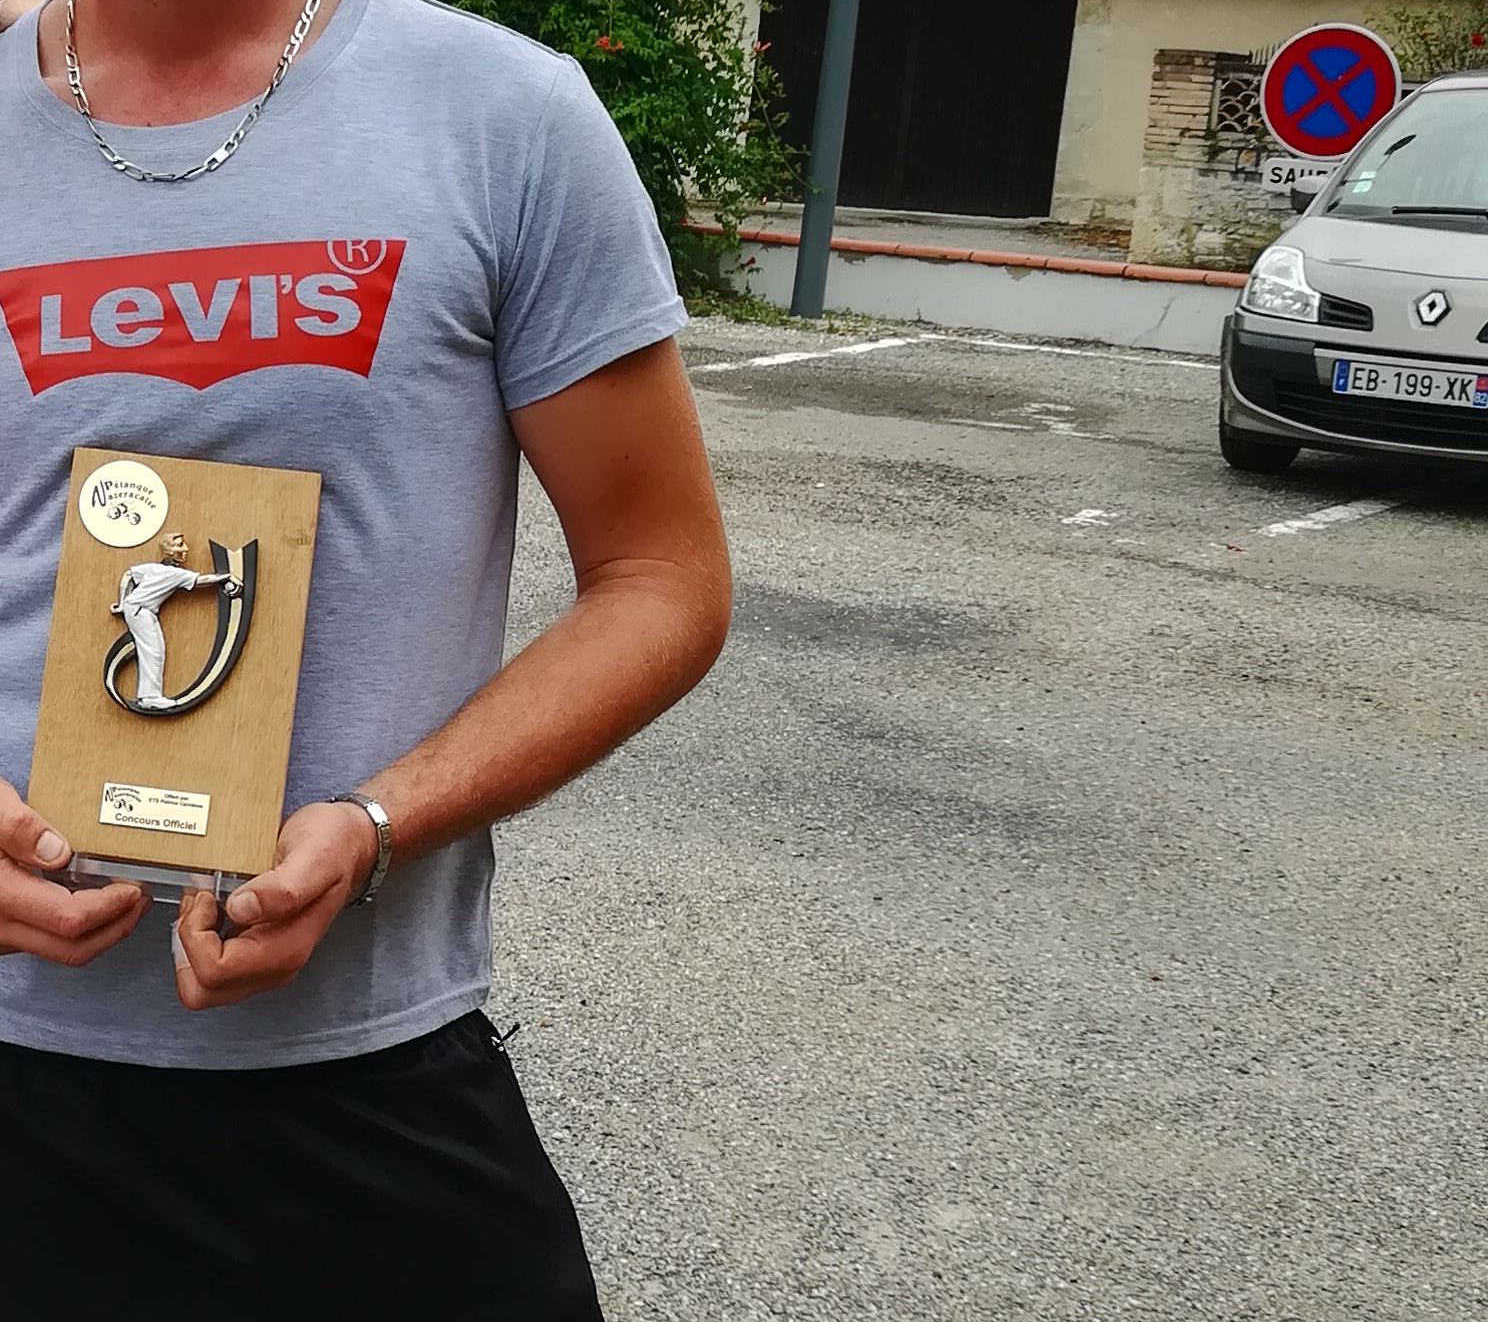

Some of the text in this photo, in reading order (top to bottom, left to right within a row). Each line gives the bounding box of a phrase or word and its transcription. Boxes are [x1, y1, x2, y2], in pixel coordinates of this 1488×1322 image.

[1351, 367, 1474, 402] EB-199-XK
[104, 480, 154, 495] Pétanque
[115, 813, 197, 830] Concours Officiel
